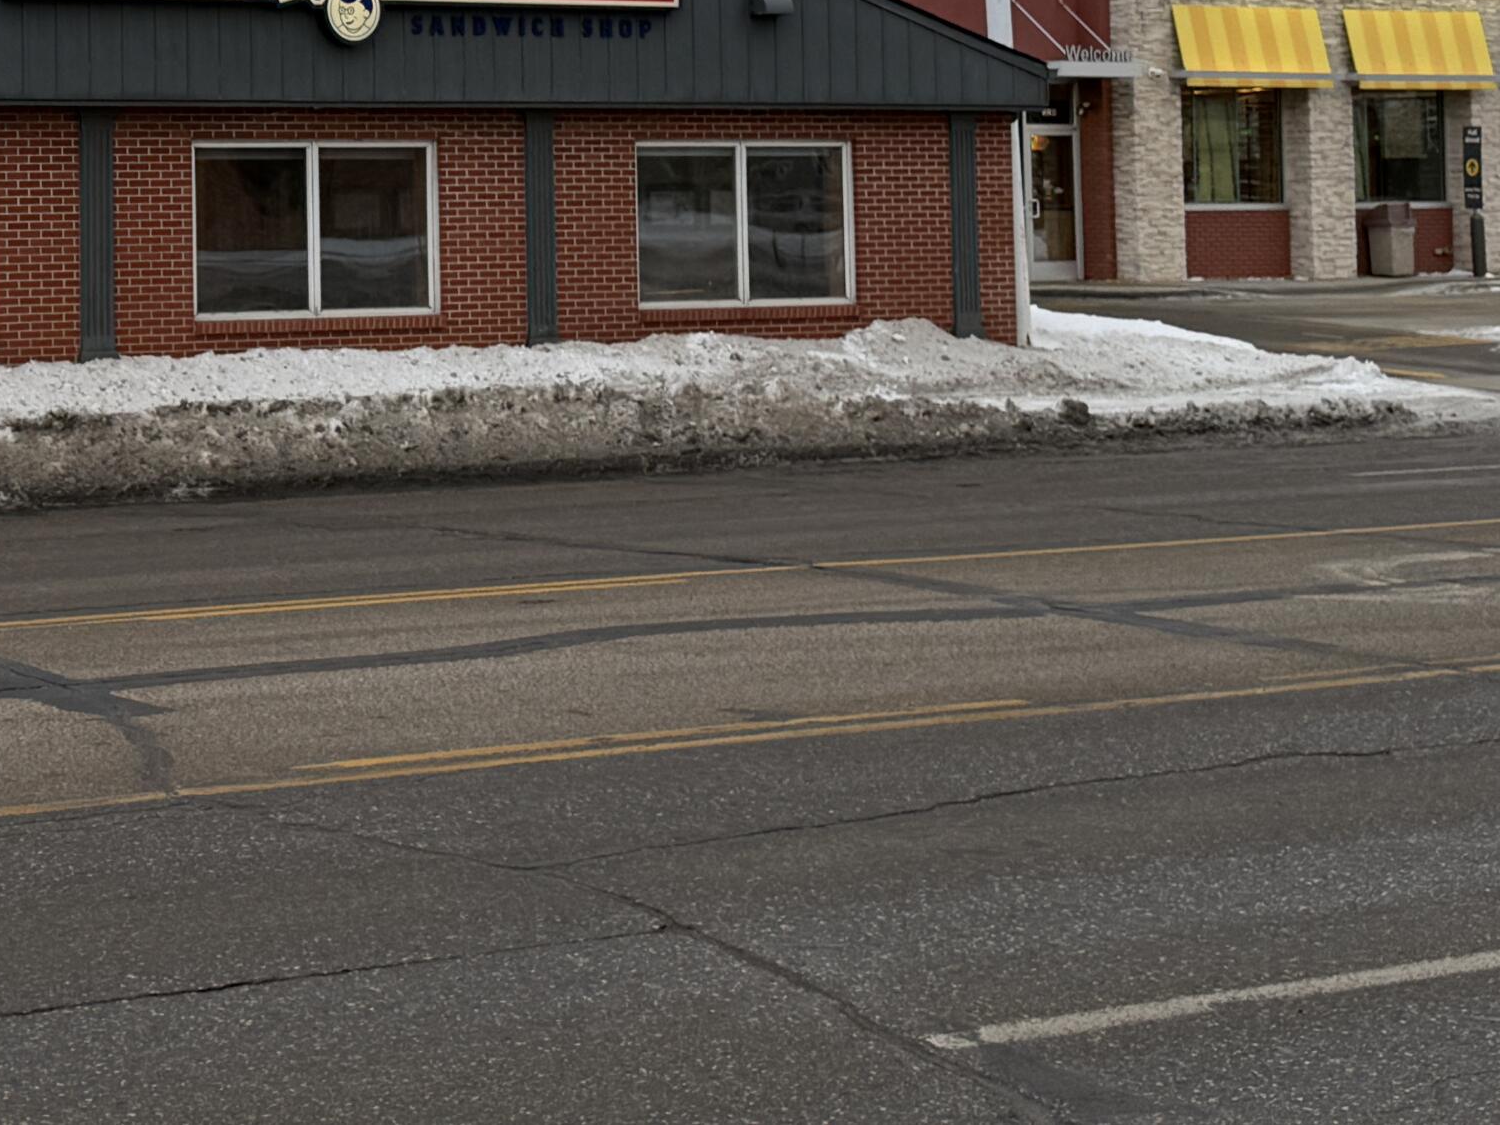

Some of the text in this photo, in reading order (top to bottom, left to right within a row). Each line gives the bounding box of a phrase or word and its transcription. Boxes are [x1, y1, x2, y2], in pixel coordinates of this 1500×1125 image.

[410, 15, 653, 39] SANDWICH SHOP
[1065, 44, 1133, 63] Welcome
